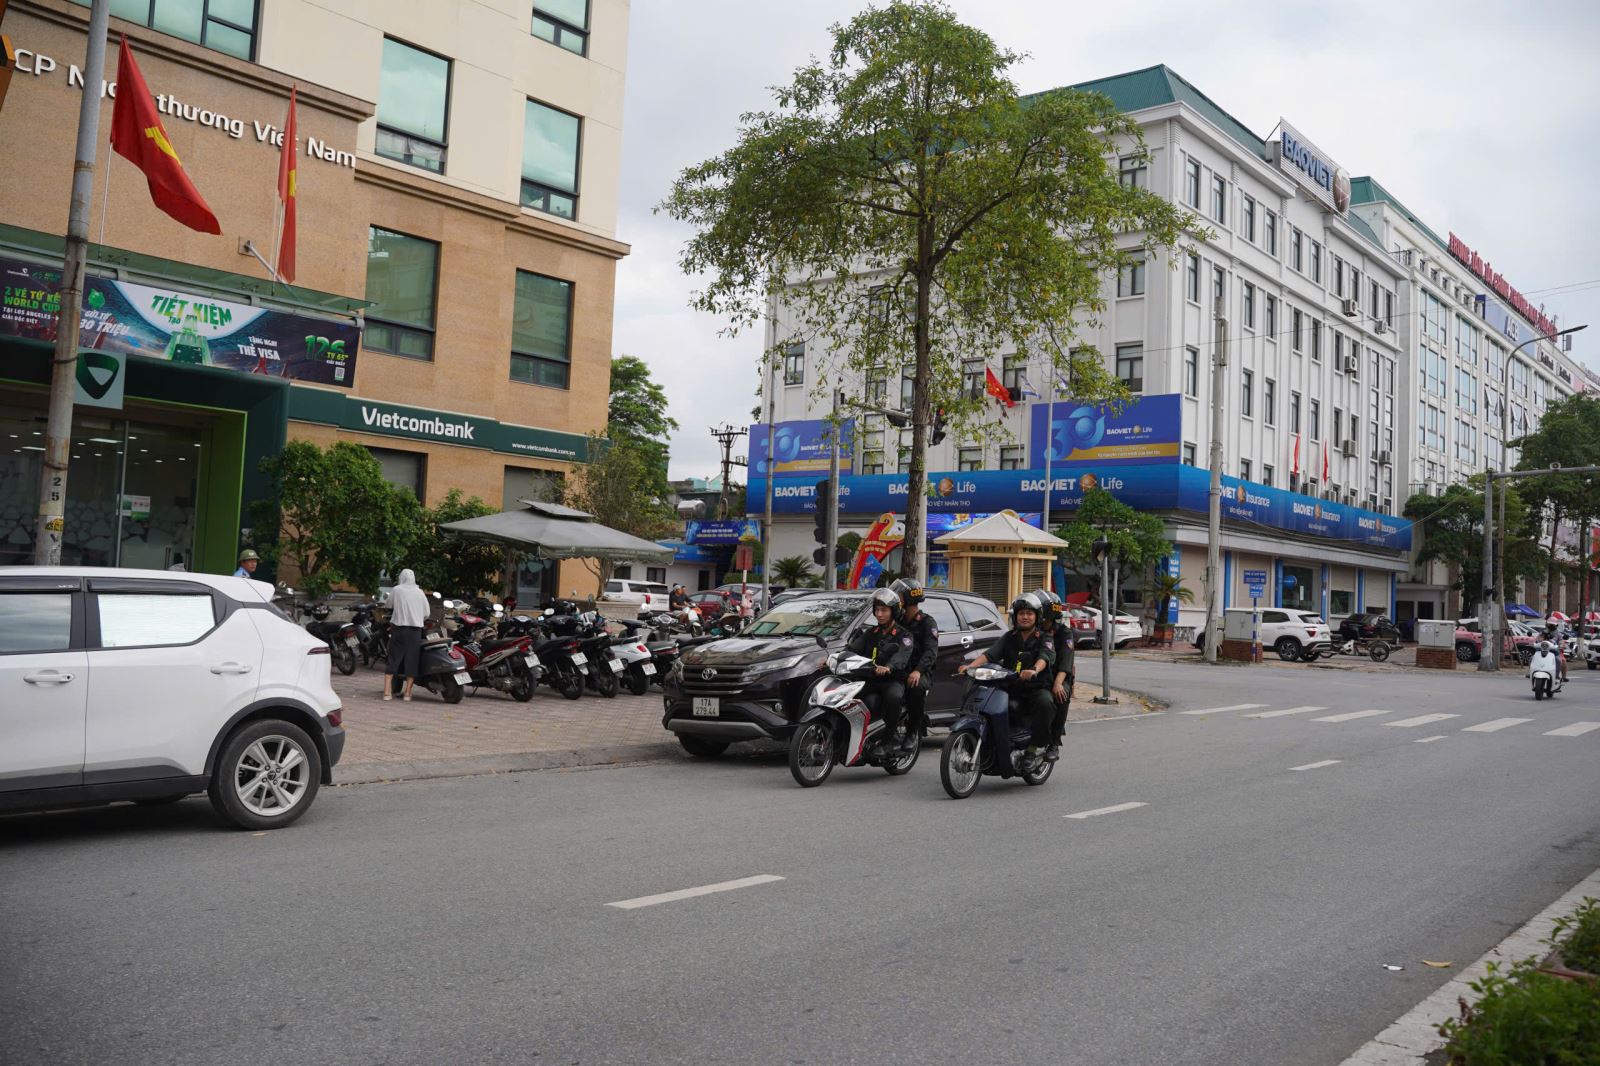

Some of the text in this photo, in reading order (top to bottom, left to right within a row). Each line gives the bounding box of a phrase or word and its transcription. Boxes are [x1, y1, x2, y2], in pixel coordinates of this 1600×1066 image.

[15, 48, 56, 76] CP
[156, 93, 244, 139] thương
[307, 137, 356, 169] Nam
[1283, 131, 1333, 192] BAOVIET
[4, 296, 39, 309] WORLD
[151, 294, 232, 330] TIẾT KIỆM
[80, 319, 95, 330] 30
[257, 347, 281, 361] VISA
[361, 406, 475, 440] Vietcombank
[957, 481, 976, 493] Life
[1101, 477, 1124, 490] Life
[774, 485, 816, 497] BAOVIET
[1246, 491, 1270, 507] Insurance
